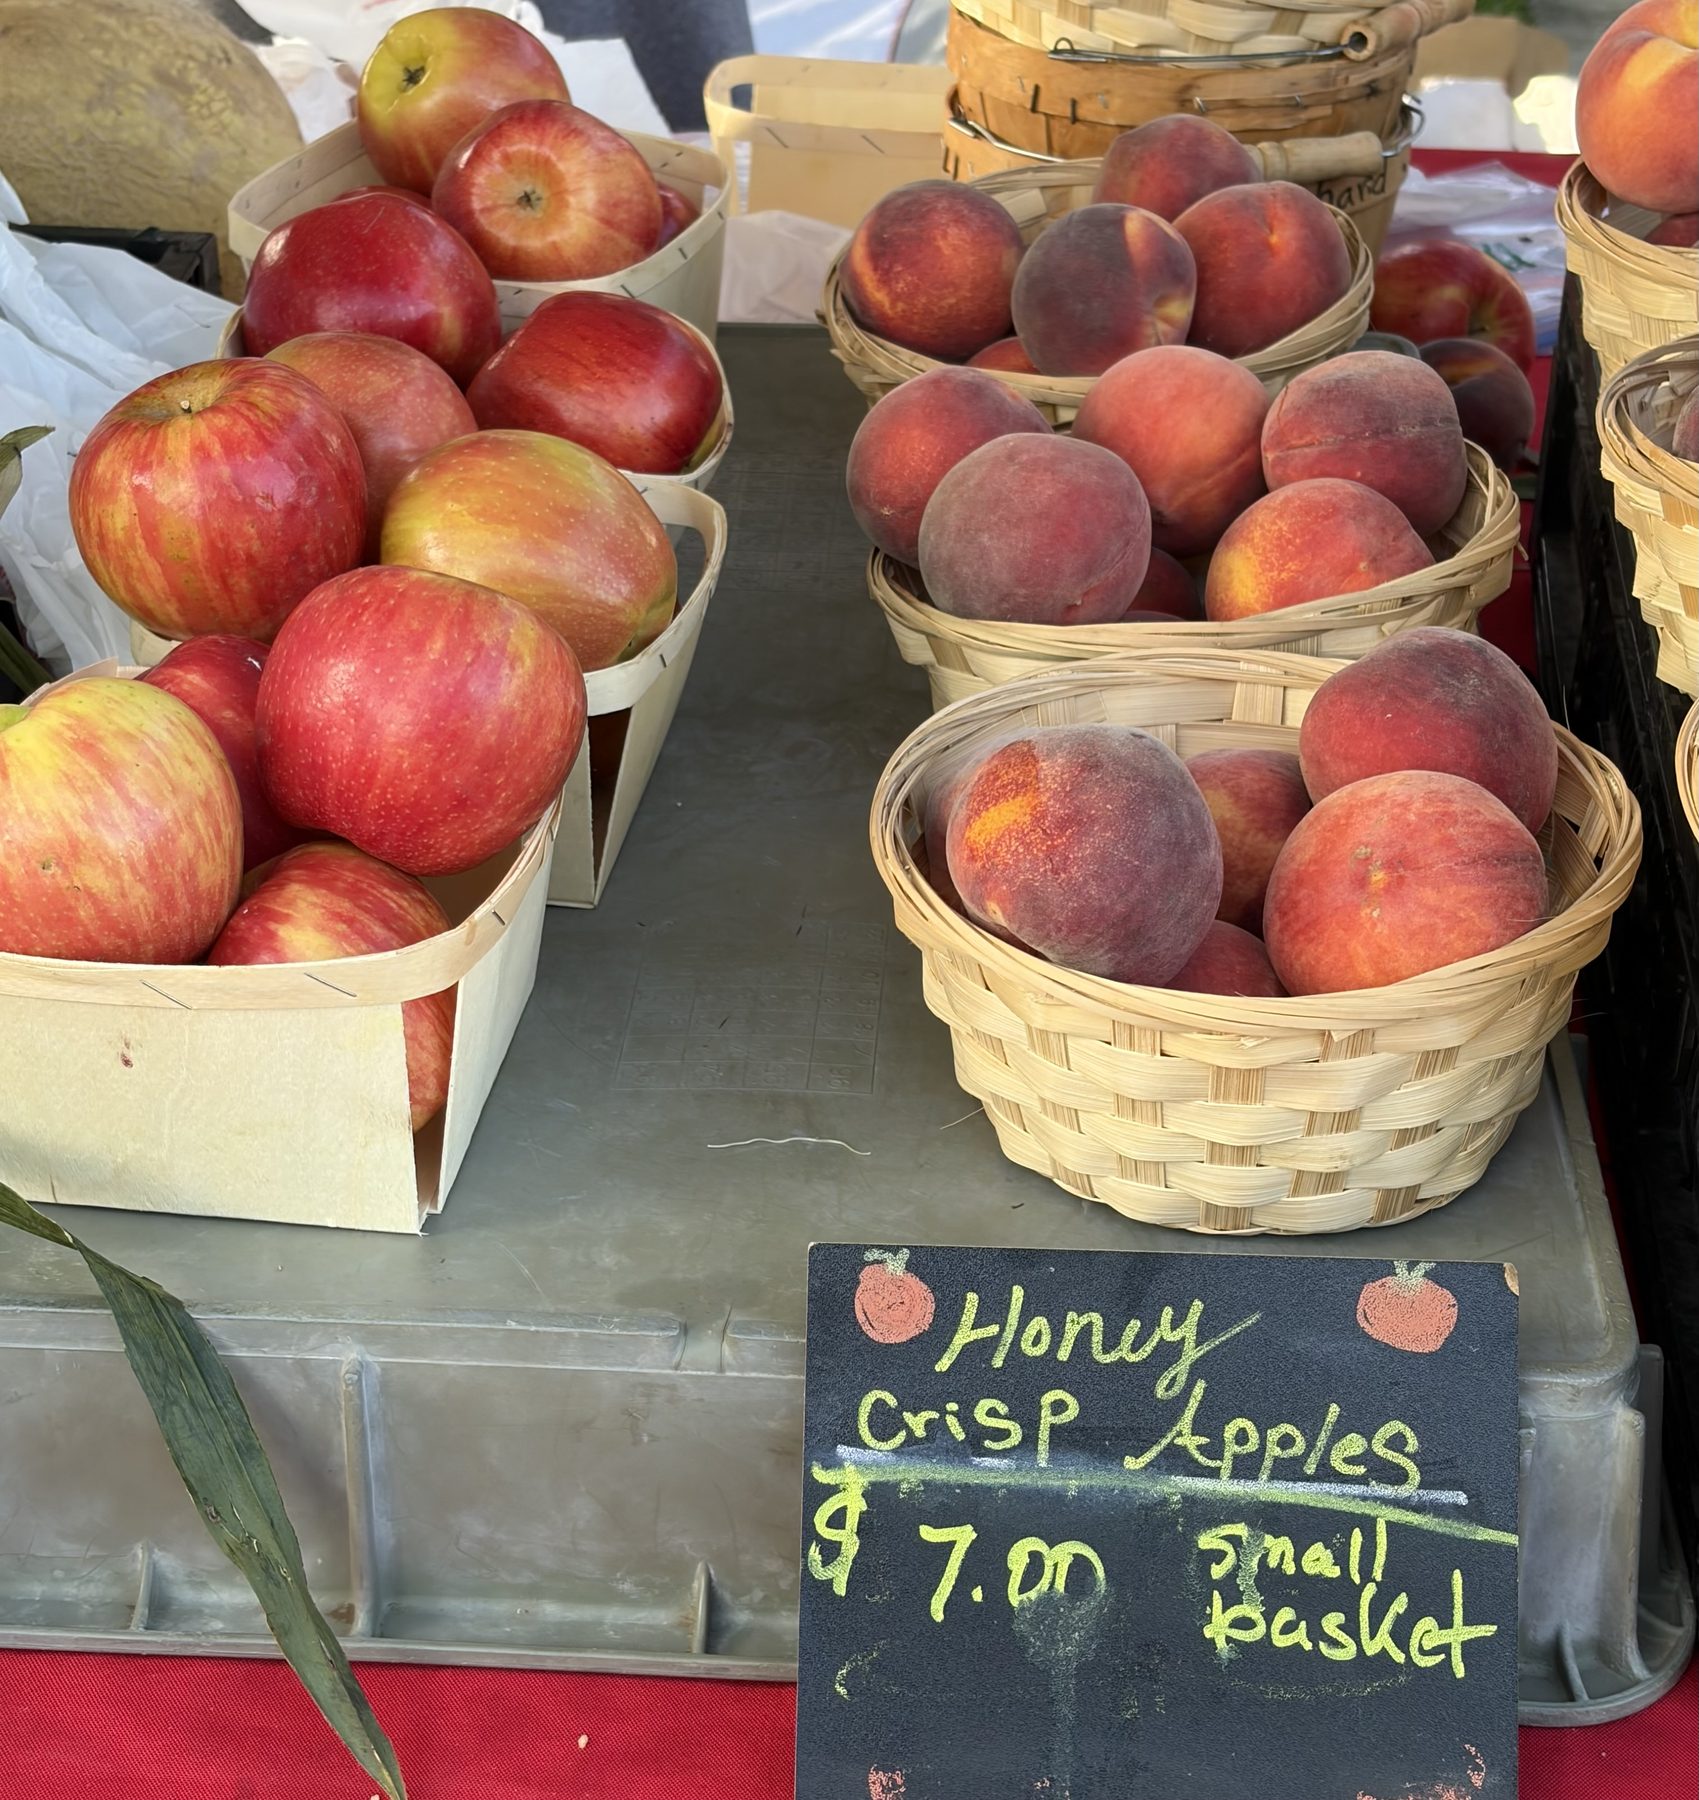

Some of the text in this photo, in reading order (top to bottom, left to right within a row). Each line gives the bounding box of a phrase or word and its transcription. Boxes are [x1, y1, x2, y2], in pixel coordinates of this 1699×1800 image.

[935, 1285, 1262, 1400] Honey
[1123, 1378, 1421, 1497] Apples
[1196, 1517, 1388, 1585] small
[1202, 1582, 1499, 1679] basket
